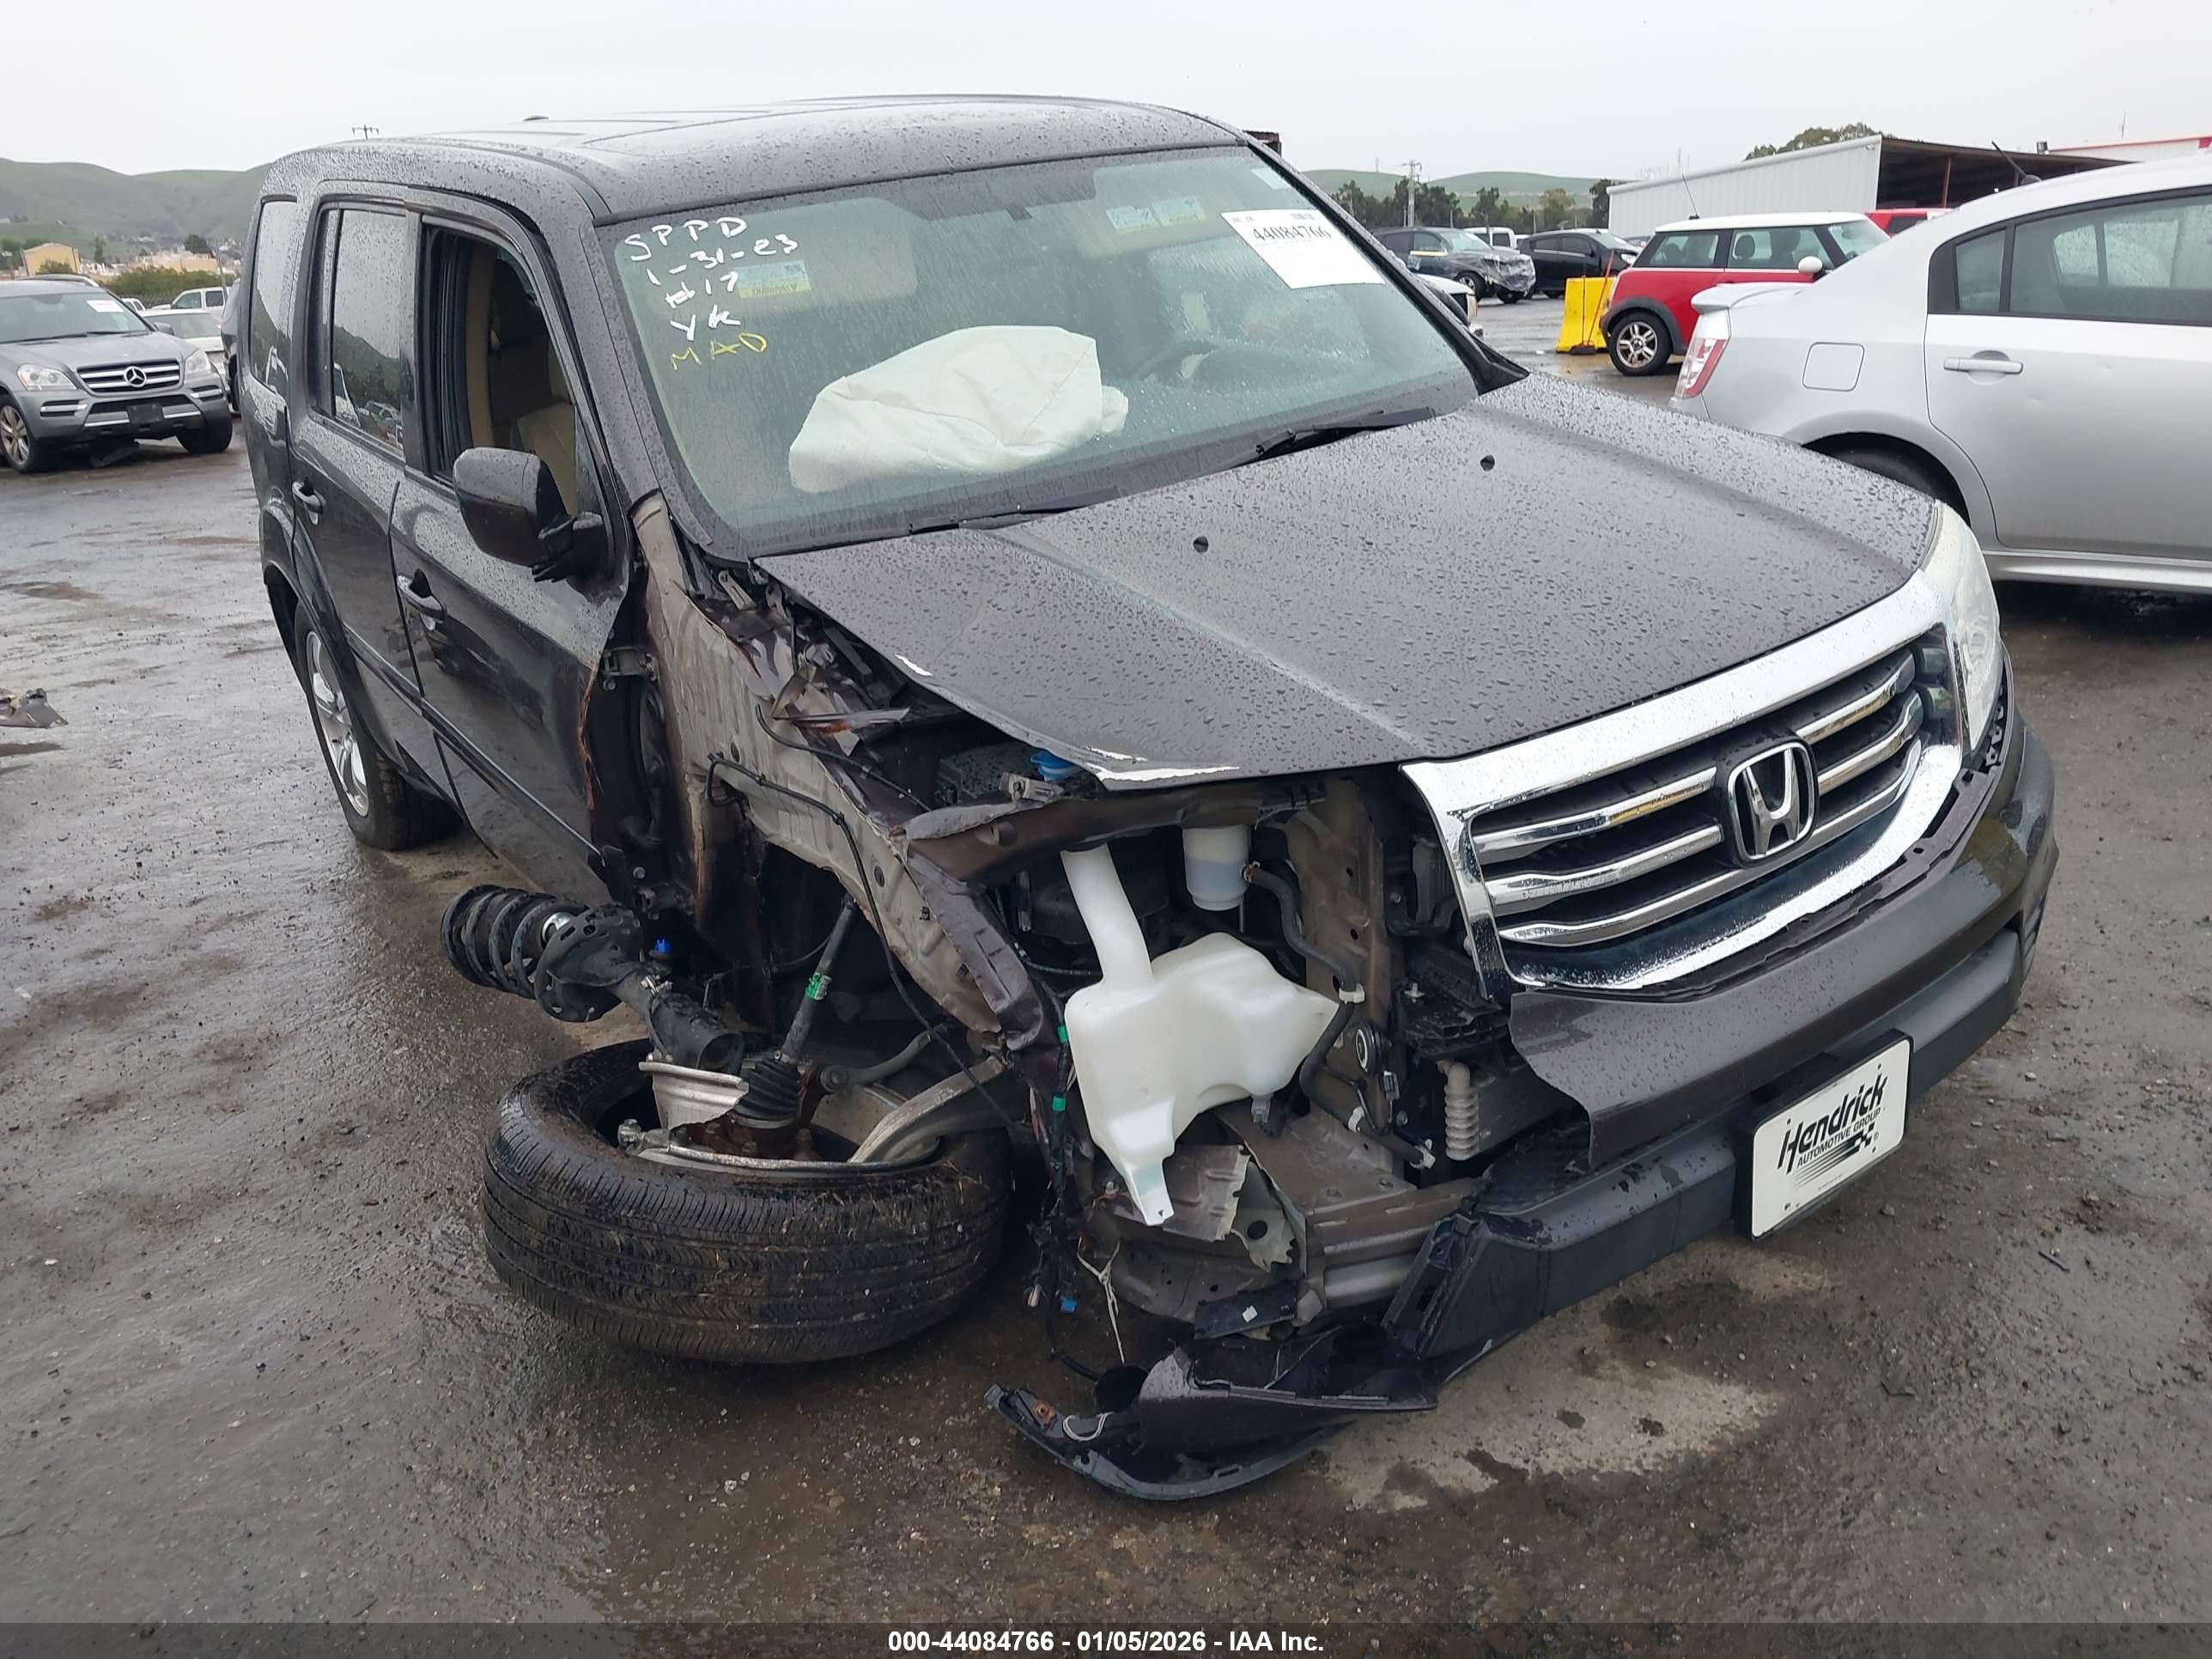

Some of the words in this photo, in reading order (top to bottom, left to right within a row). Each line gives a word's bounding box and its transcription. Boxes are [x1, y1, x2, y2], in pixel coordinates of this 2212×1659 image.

[625, 217, 747, 261] SPPD
[670, 332, 767, 370] MAD
[1777, 1073, 1888, 1175] Hendrick
[1796, 1127, 1850, 1169] AUTOMOTIVE
[1853, 1107, 1881, 1133] GROUP
